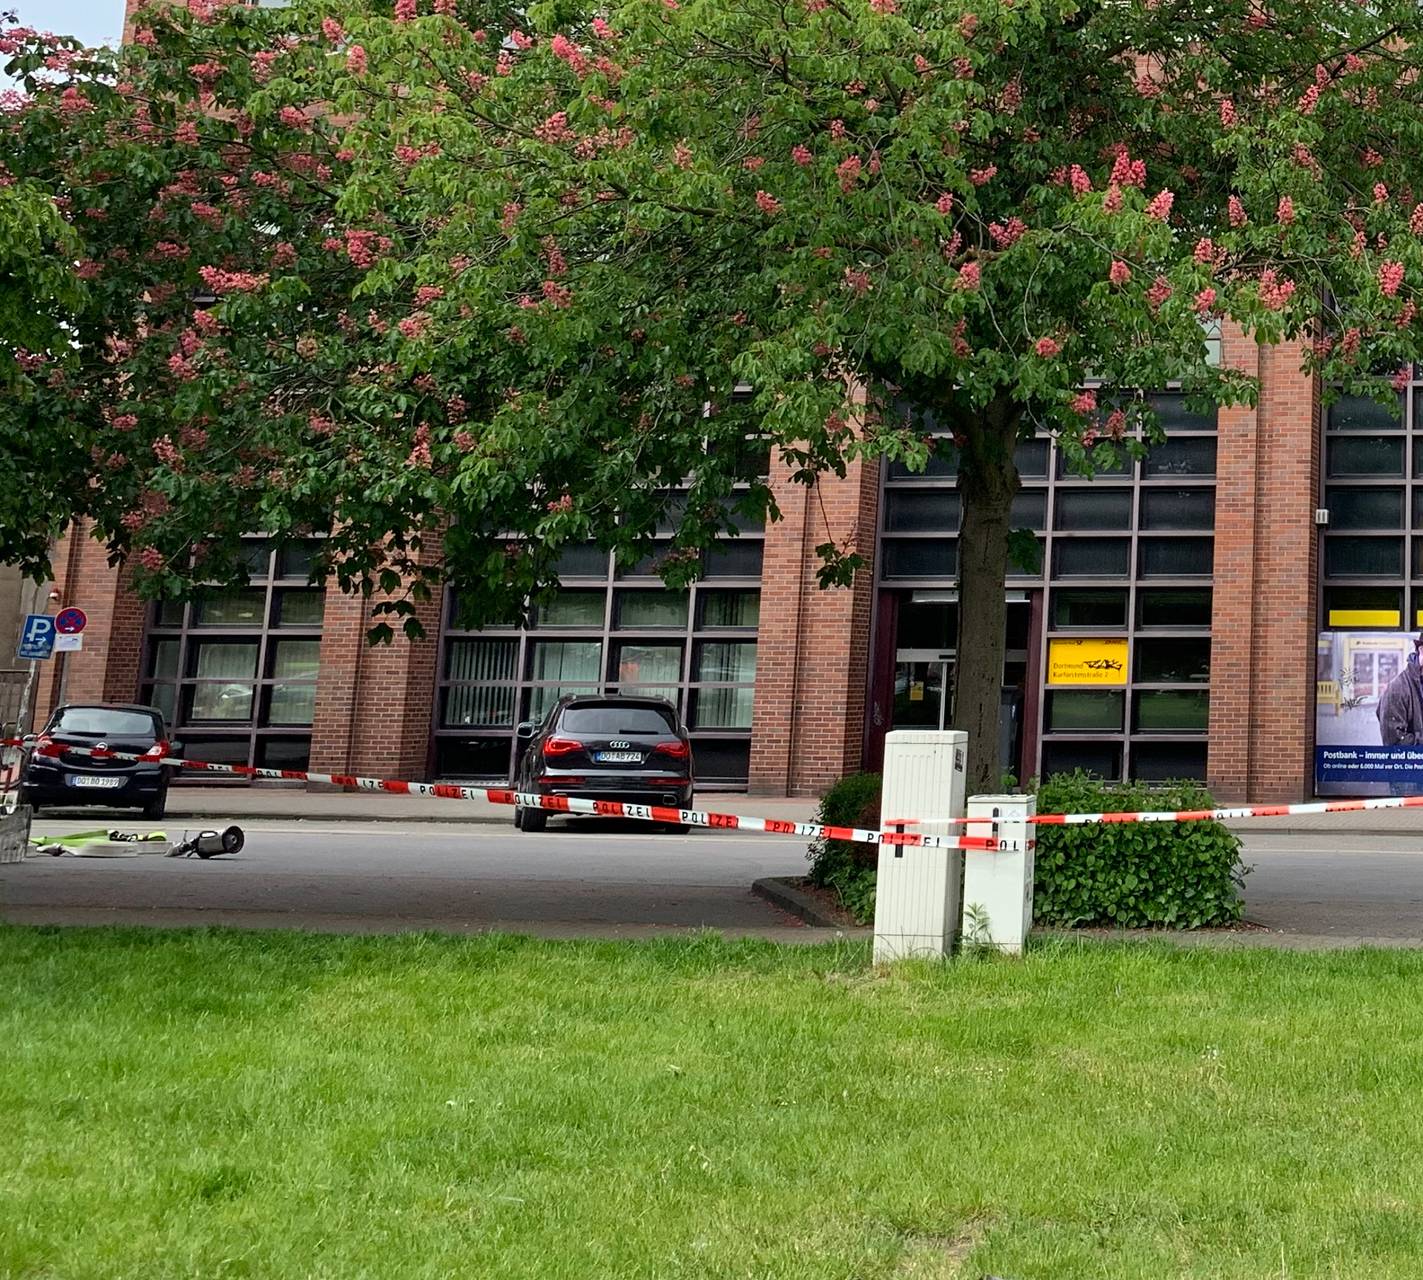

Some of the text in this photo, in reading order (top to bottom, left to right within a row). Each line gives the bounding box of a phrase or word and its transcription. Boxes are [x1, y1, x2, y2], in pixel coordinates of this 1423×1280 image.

[1323, 751, 1358, 760] Postbank
[1365, 751, 1389, 760] immer
[1391, 751, 1405, 760] und
[420, 785, 474, 800] POLIZEI
[505, 793, 562, 808] POLIZEI
[593, 802, 651, 818] POLIZEI
[682, 811, 739, 828] POLIZEI
